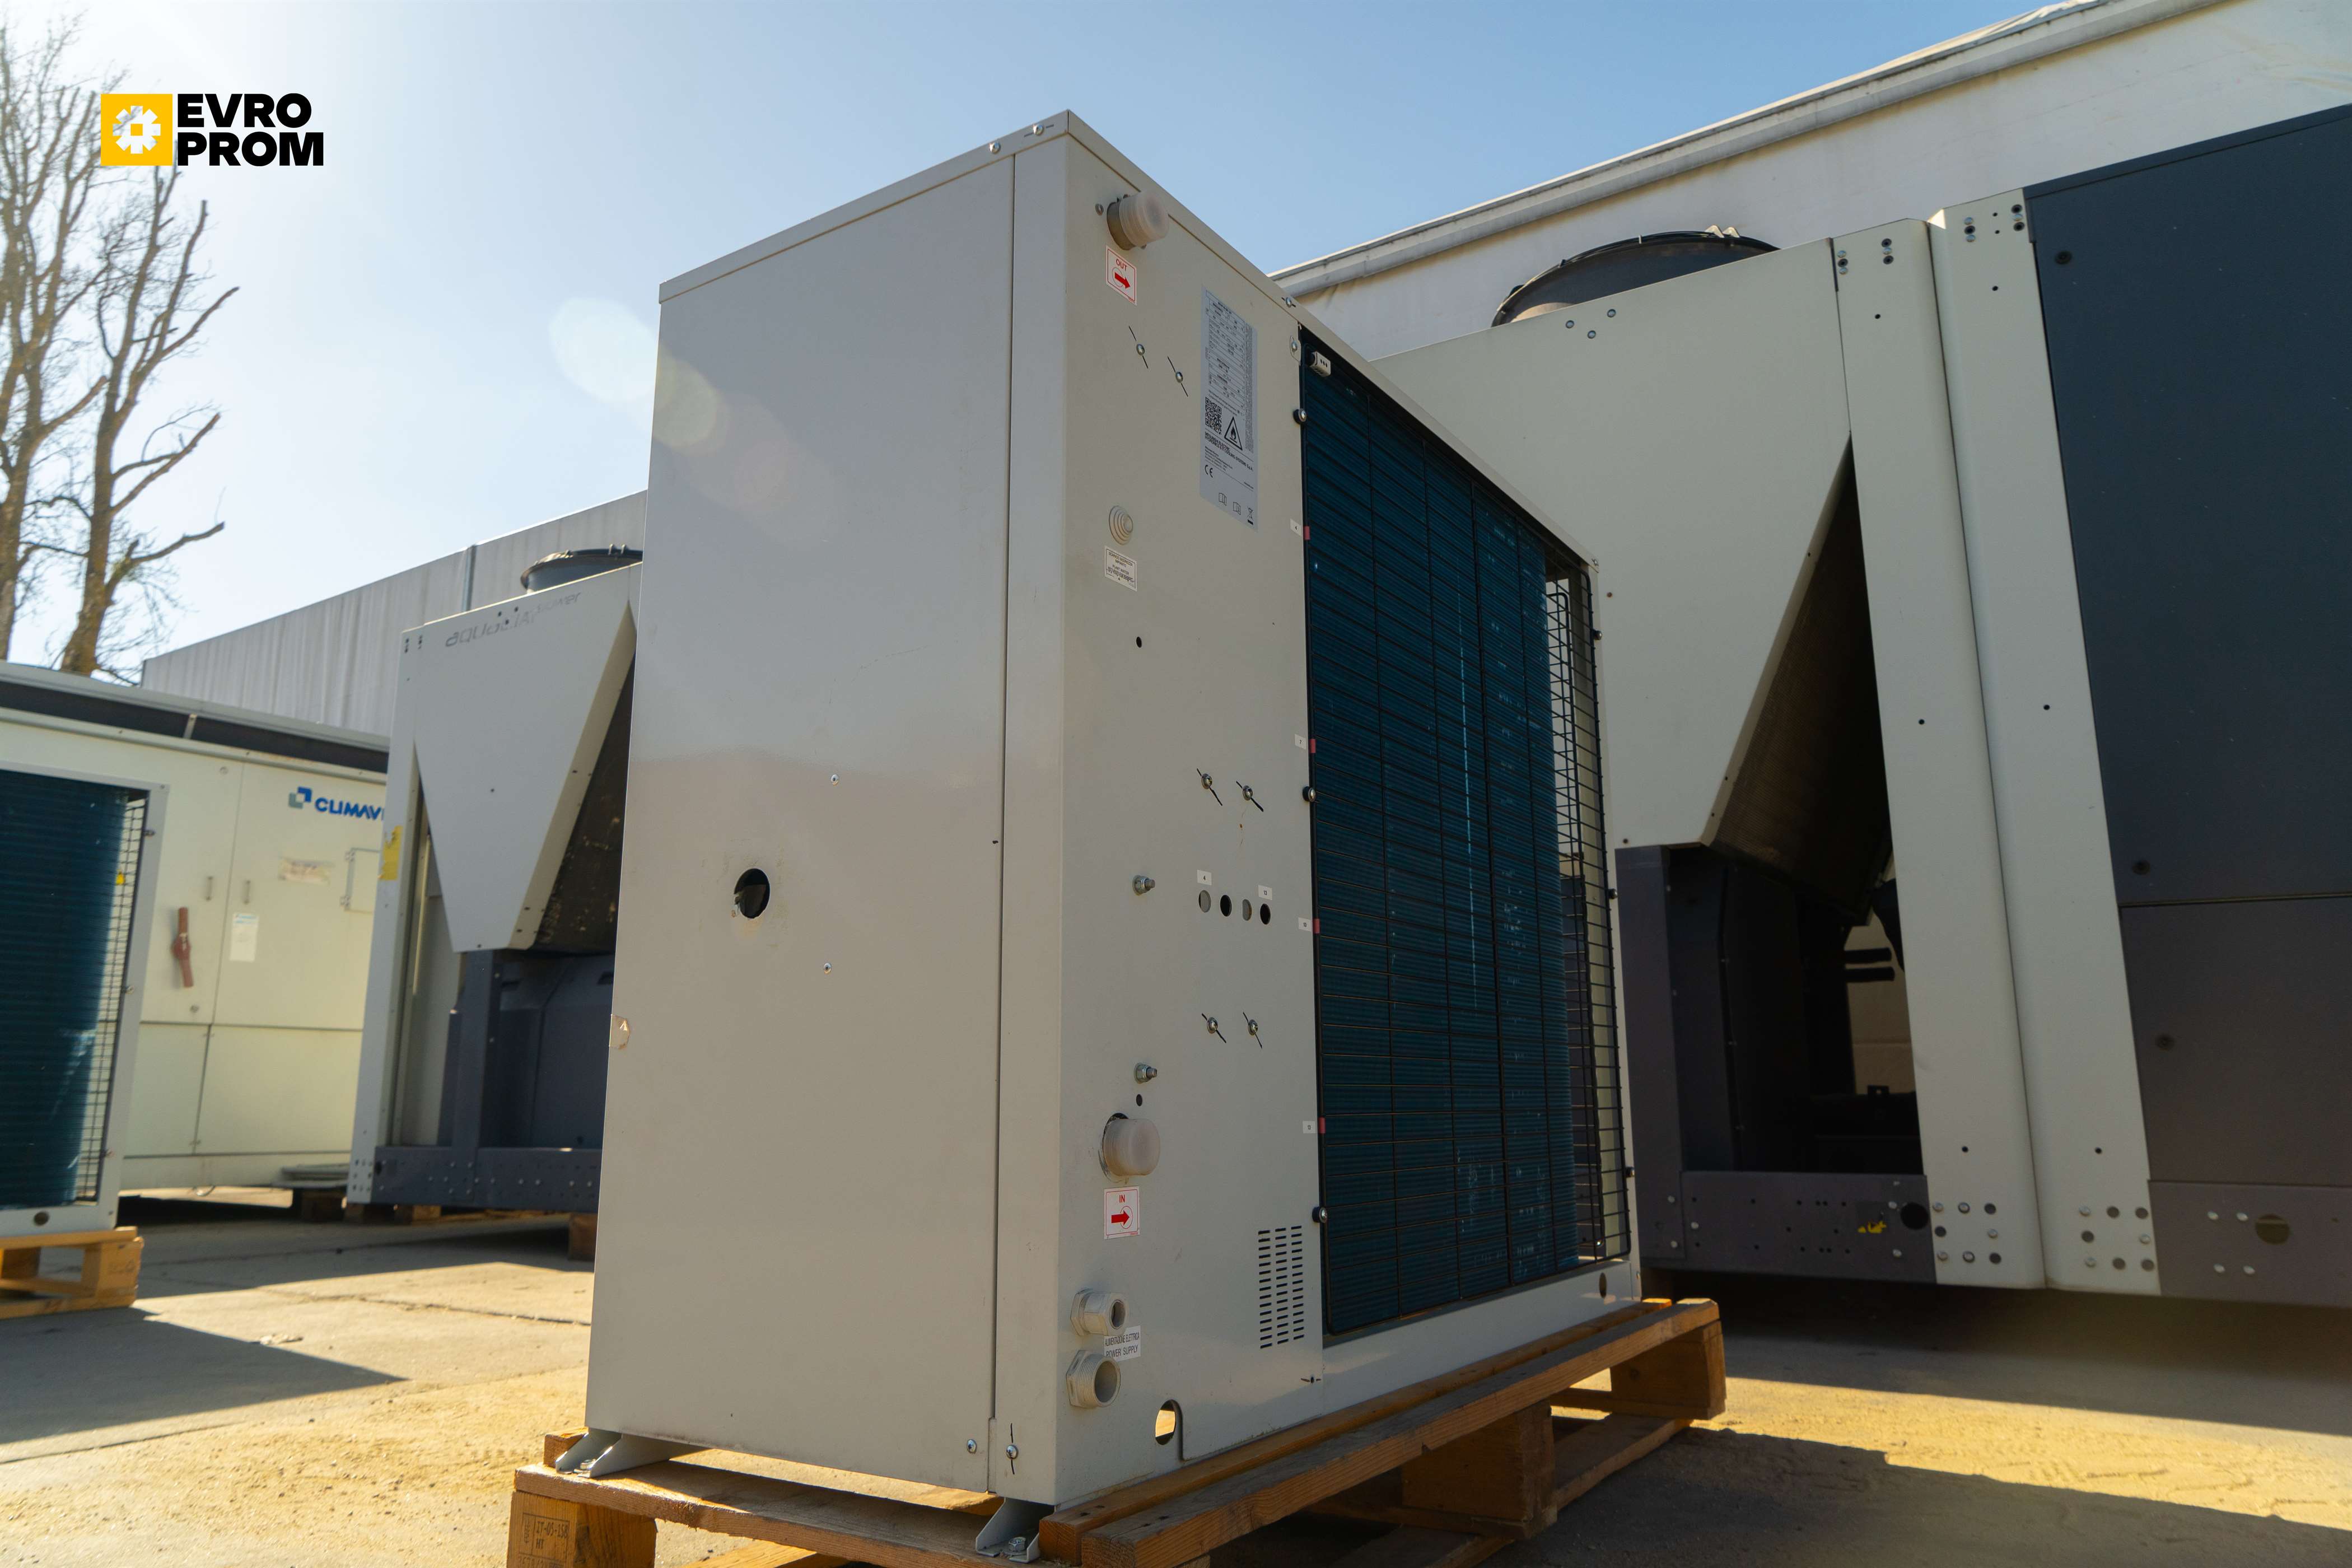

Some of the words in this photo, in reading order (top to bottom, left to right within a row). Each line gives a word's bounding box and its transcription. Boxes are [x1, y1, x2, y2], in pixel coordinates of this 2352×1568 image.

[1116, 258, 1127, 272] OUT
[315, 797, 385, 821] CLIMAV
[1119, 1194, 1126, 1203] IN
[1106, 1348, 1121, 1357] POWER
[1123, 1344, 1138, 1355] SUPPLY
[536, 1538, 544, 1549] HT
